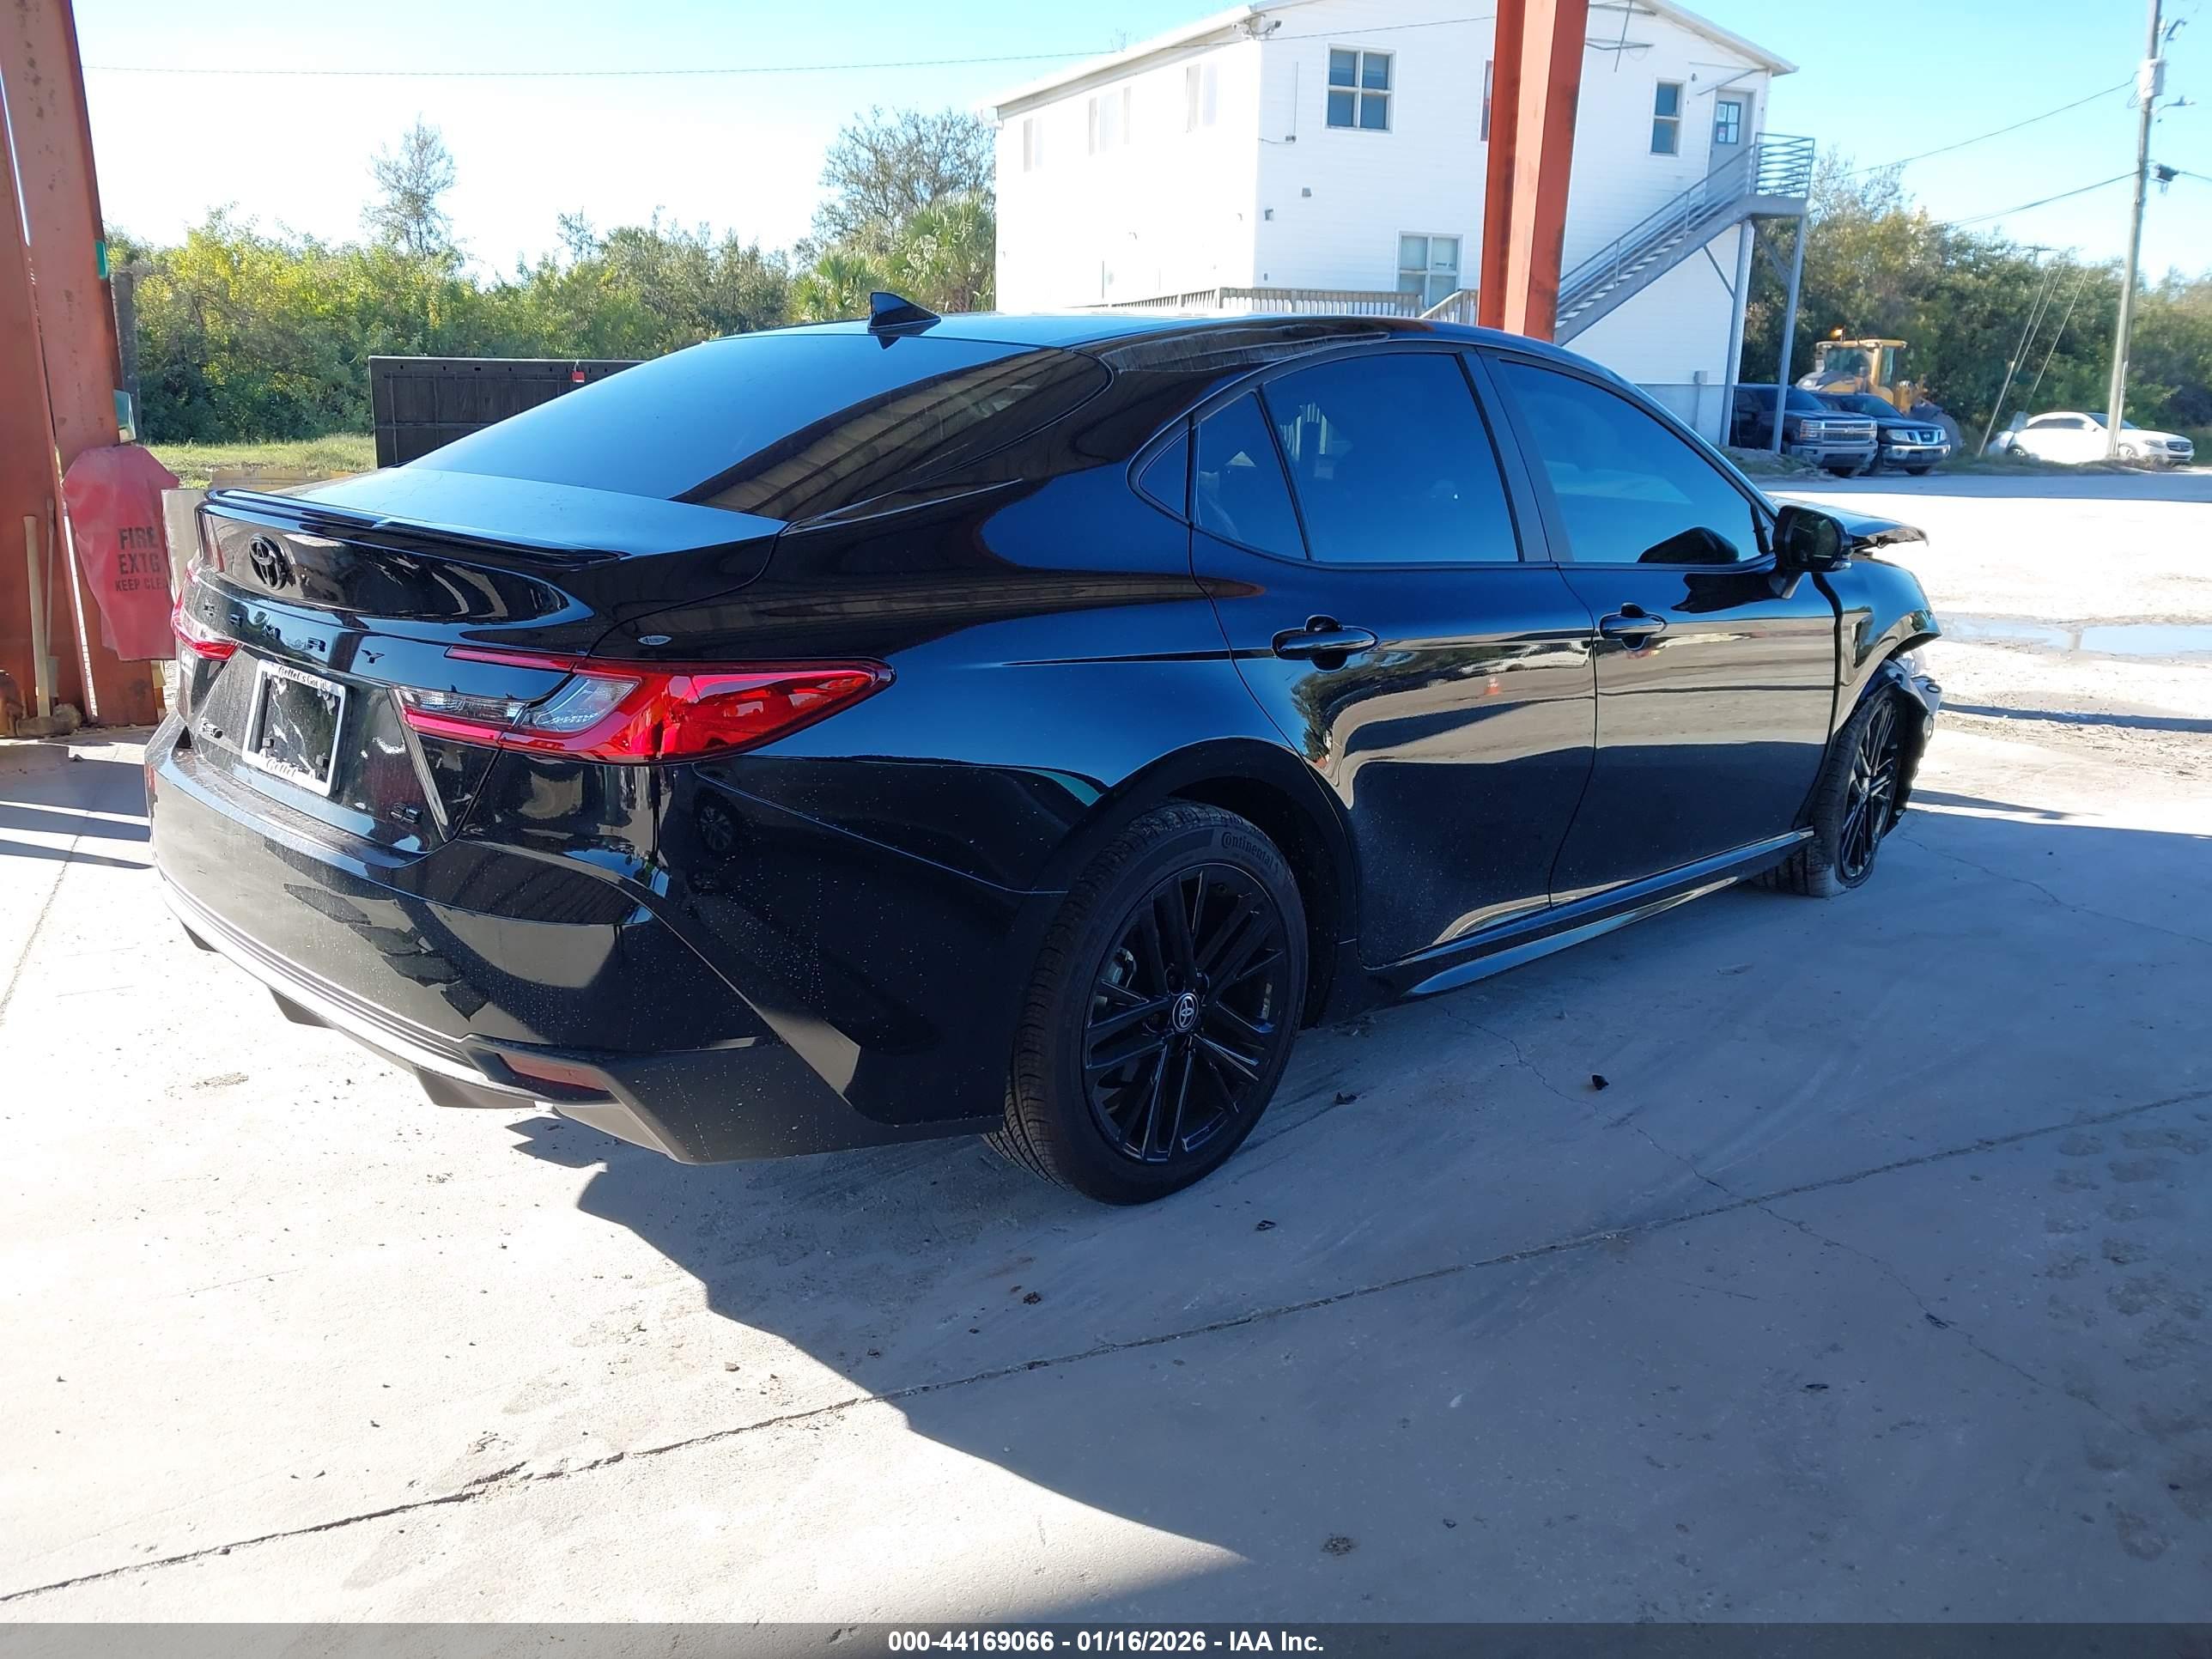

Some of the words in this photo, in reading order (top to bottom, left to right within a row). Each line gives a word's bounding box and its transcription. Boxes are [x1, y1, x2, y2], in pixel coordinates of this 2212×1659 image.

[118, 526, 159, 550] FIRE
[118, 552, 161, 574] EXTG
[114, 578, 141, 592] KEEP
[1221, 831, 1275, 868] Continental
